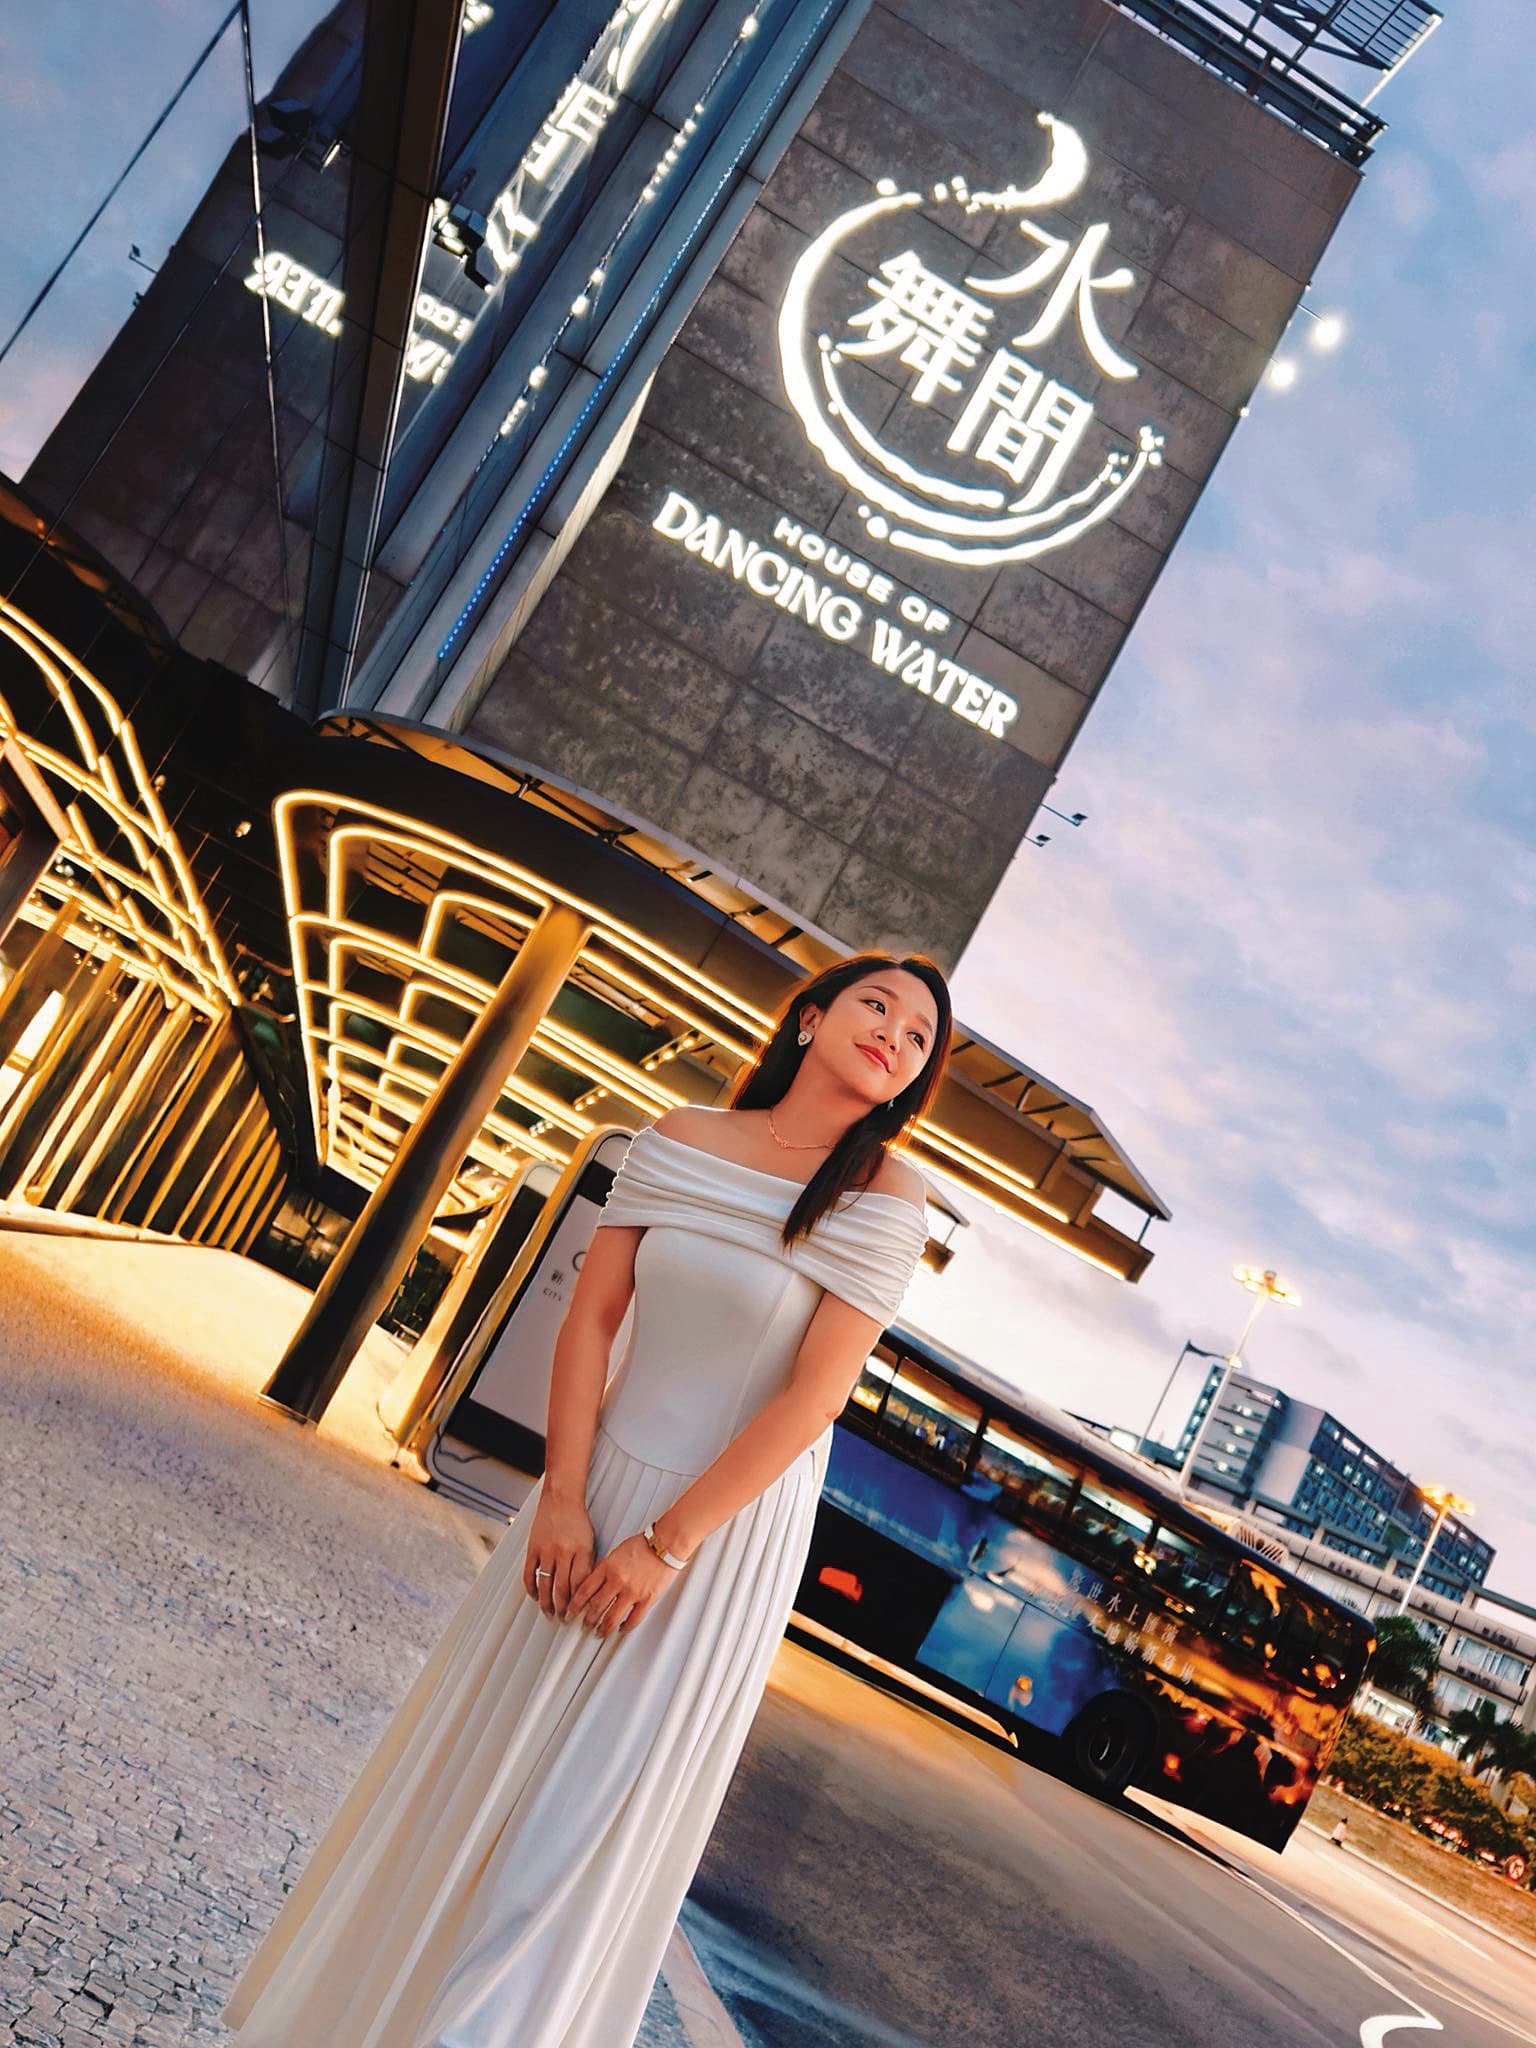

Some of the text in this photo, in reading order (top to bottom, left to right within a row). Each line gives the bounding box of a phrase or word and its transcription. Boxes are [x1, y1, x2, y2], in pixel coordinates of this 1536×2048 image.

[652, 491, 1018, 739] DANCING WATER
[773, 516, 951, 632] HOUSE OF
